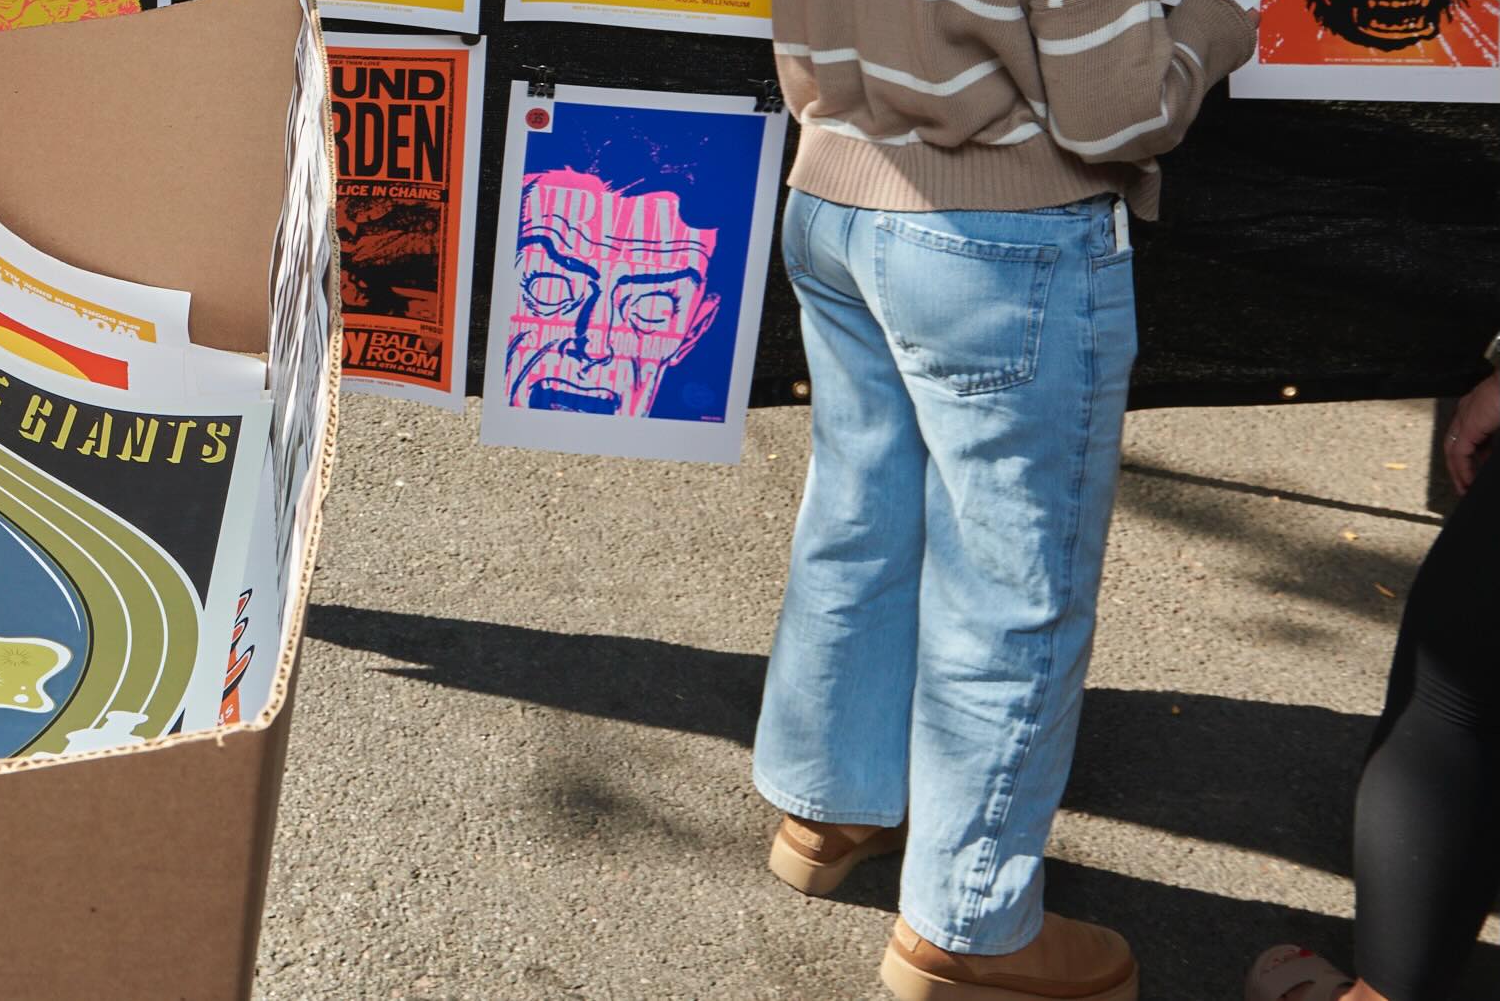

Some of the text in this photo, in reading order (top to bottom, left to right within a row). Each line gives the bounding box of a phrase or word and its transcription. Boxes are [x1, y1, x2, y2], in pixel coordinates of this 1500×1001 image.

[332, 67, 446, 101] UND
[332, 101, 446, 183] RDEN
[337, 184, 441, 200] LICE IN CHAINS
[523, 185, 703, 268] NIRVANA
[366, 346, 438, 370] ROOM
[371, 332, 428, 354] BALL
[18, 394, 231, 464] GIANTS
